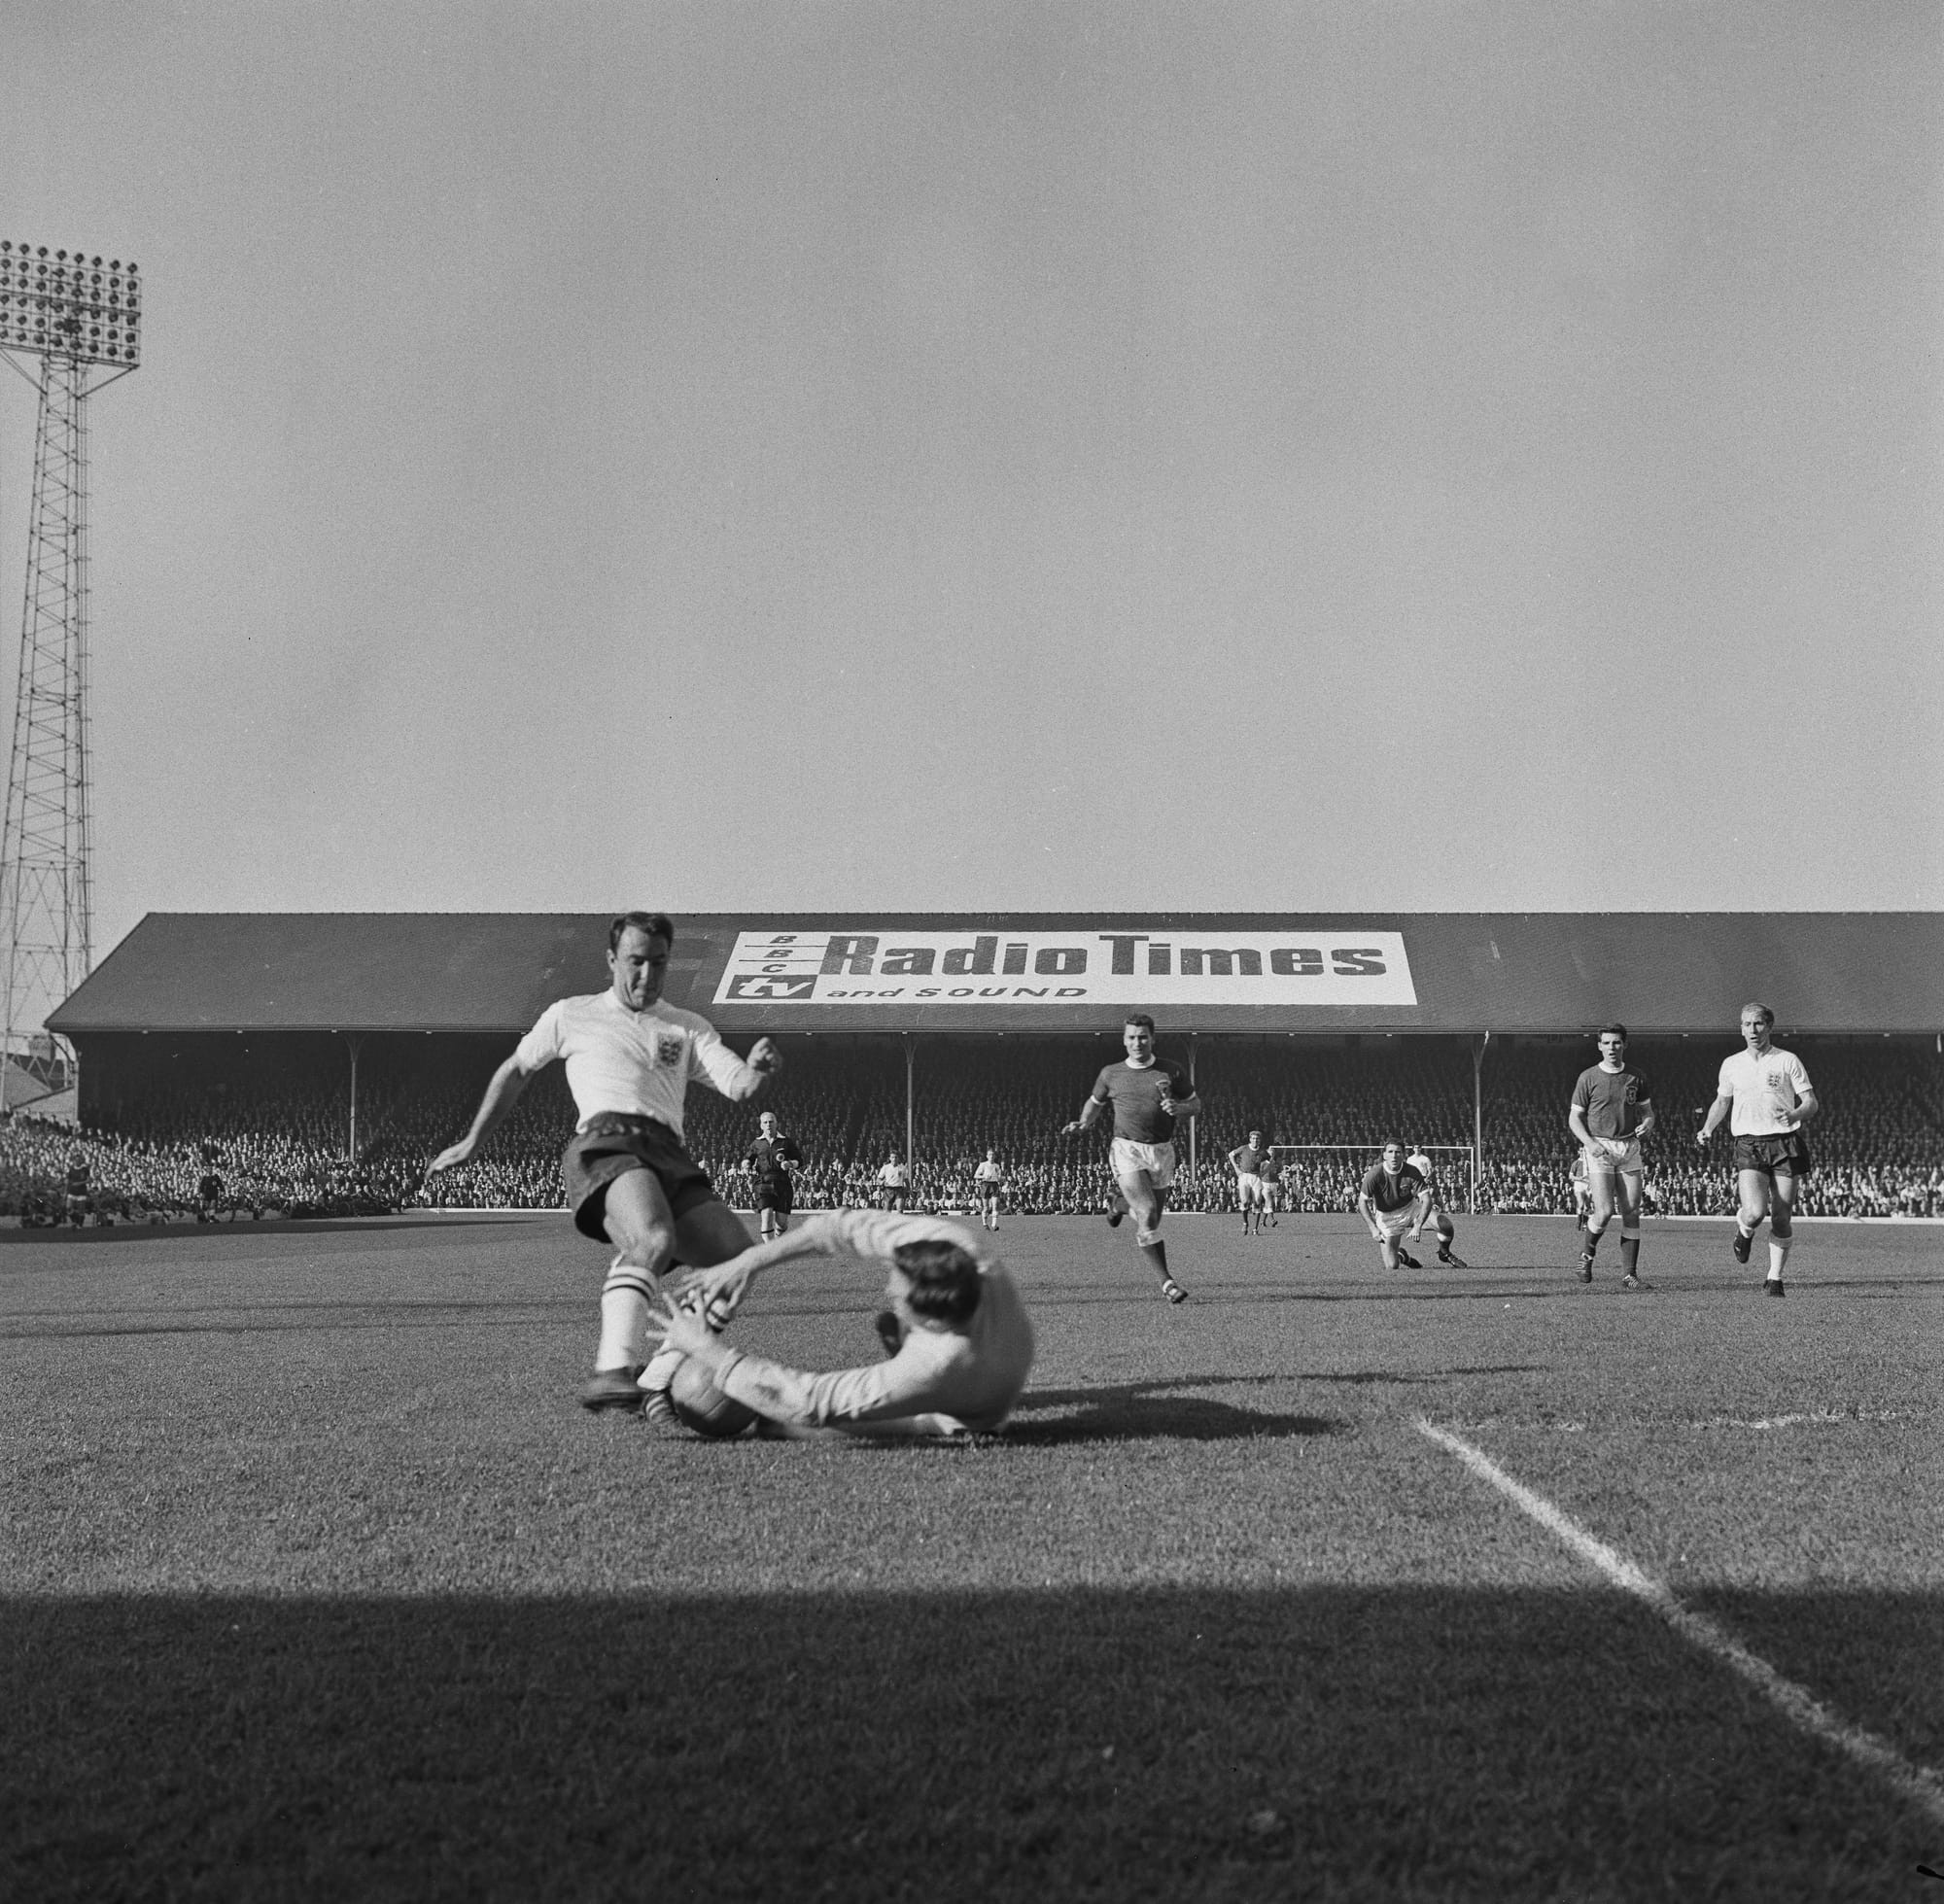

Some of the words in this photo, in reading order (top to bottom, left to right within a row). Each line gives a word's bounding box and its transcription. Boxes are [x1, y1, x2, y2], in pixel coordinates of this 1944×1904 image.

[818, 935, 1089, 976] Radio
[1098, 934, 1387, 977] Times
[737, 976, 814, 998] tv
[826, 987, 906, 998] and
[915, 987, 1088, 998] SOUND
